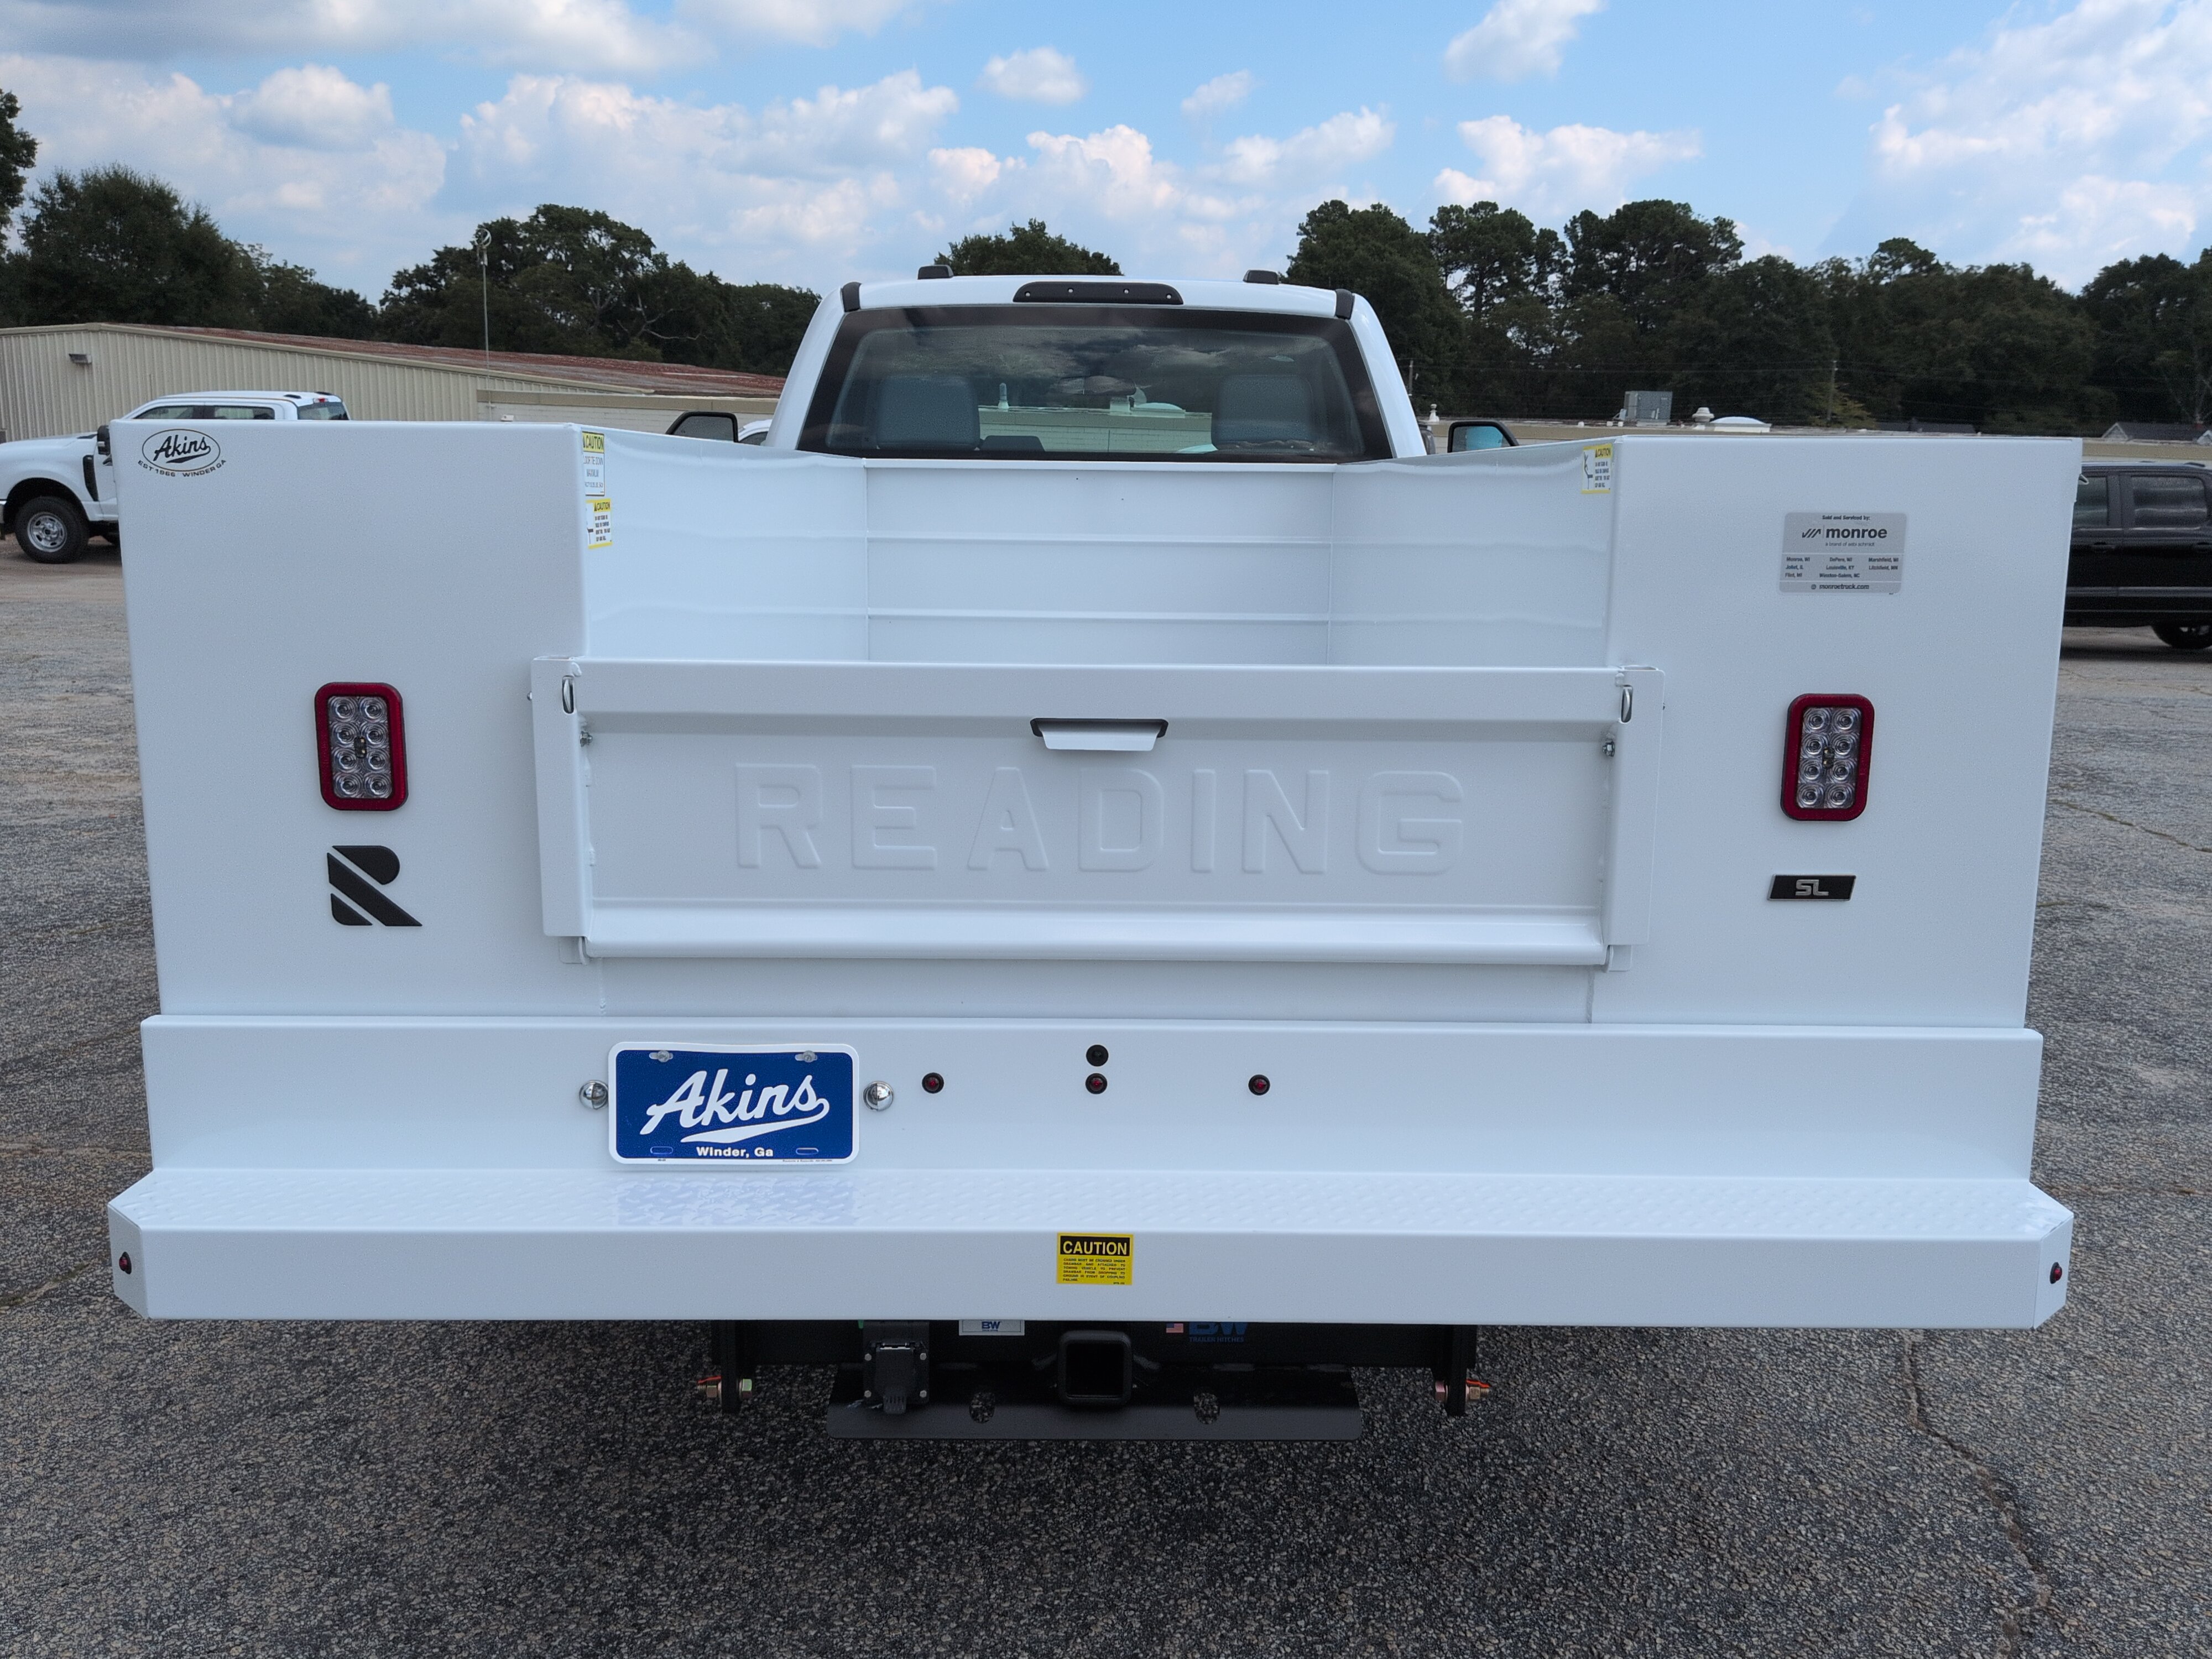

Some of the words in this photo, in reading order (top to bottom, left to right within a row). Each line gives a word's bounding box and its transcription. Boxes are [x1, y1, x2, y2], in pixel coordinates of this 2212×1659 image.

[153, 435, 211, 462] Akins
[138, 460, 154, 471] EST
[155, 469, 176, 477] 1966
[182, 467, 216, 477] WINDER
[217, 460, 227, 468] GA
[1826, 528, 1887, 539] monroe
[735, 762, 1466, 875] READING
[1795, 879, 1829, 896] SL
[640, 1068, 830, 1140] Akins
[696, 1146, 750, 1158] Winder,
[754, 1147, 774, 1157] Ga
[1063, 1240, 1127, 1255] CAUTION
